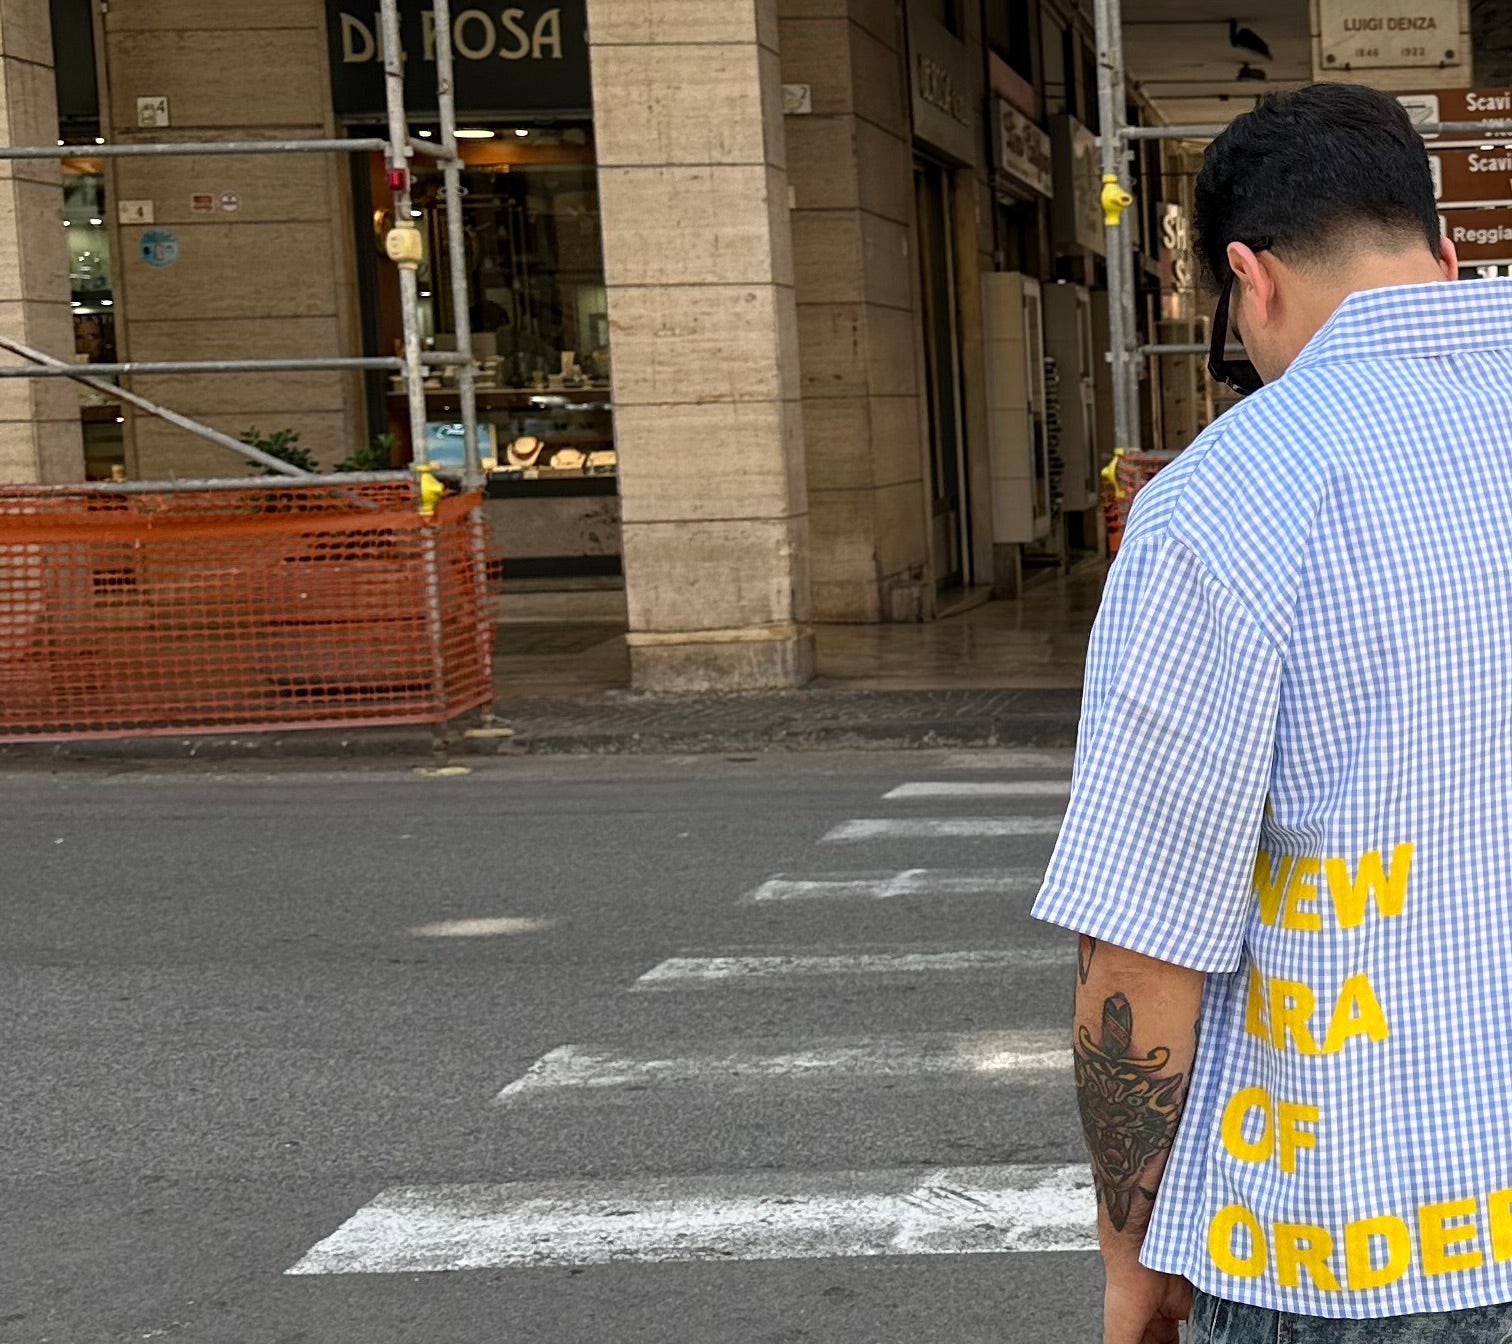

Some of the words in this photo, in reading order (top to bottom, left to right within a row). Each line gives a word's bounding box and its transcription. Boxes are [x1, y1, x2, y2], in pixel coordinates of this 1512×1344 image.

[1343, 18, 1383, 32] LUIGI
[1387, 17, 1437, 31] DENZA
[1465, 92, 1511, 112] Scavi
[1468, 153, 1512, 173] Scavi
[1251, 841, 1414, 933] NEW
[1220, 1086, 1320, 1174] OF
